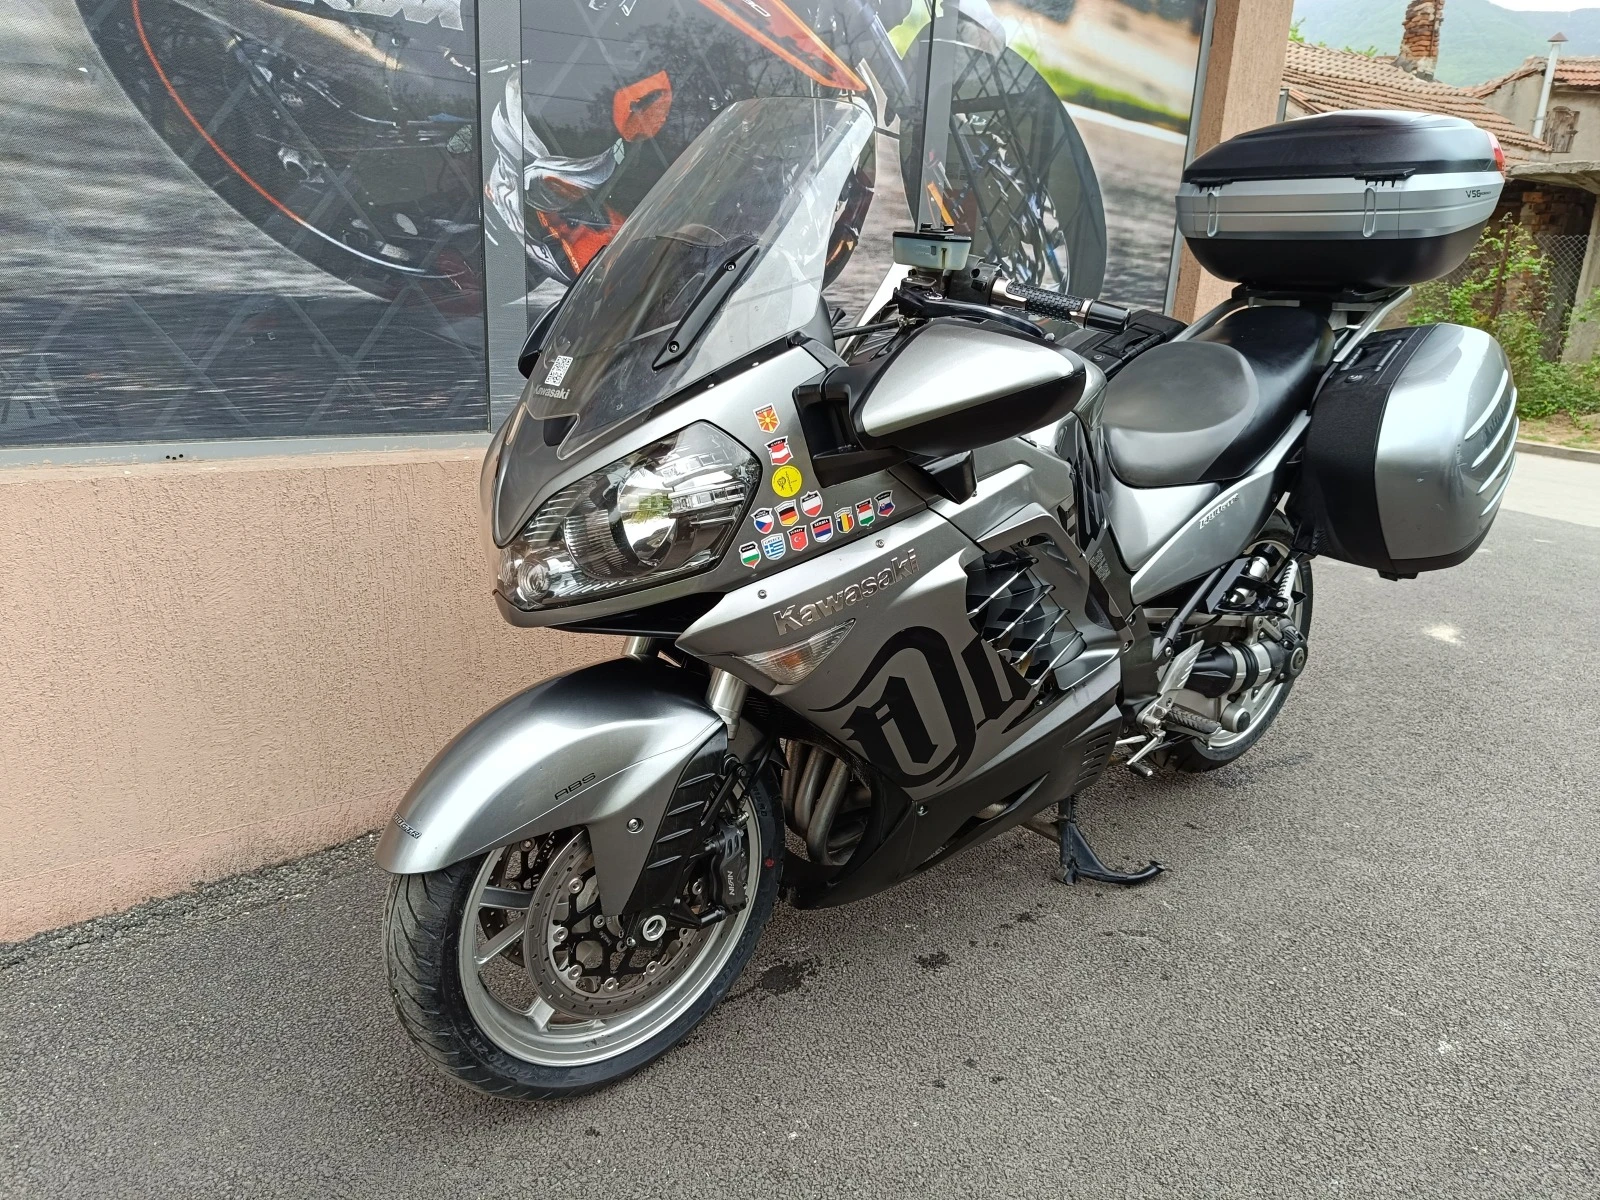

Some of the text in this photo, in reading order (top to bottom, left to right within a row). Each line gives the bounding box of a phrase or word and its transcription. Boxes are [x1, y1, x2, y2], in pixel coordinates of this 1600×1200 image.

[535, 385, 571, 399] Kawasaki
[773, 548, 920, 636] Kawasaki
[554, 772, 596, 800] ABS
[727, 870, 735, 896] NISSIN
